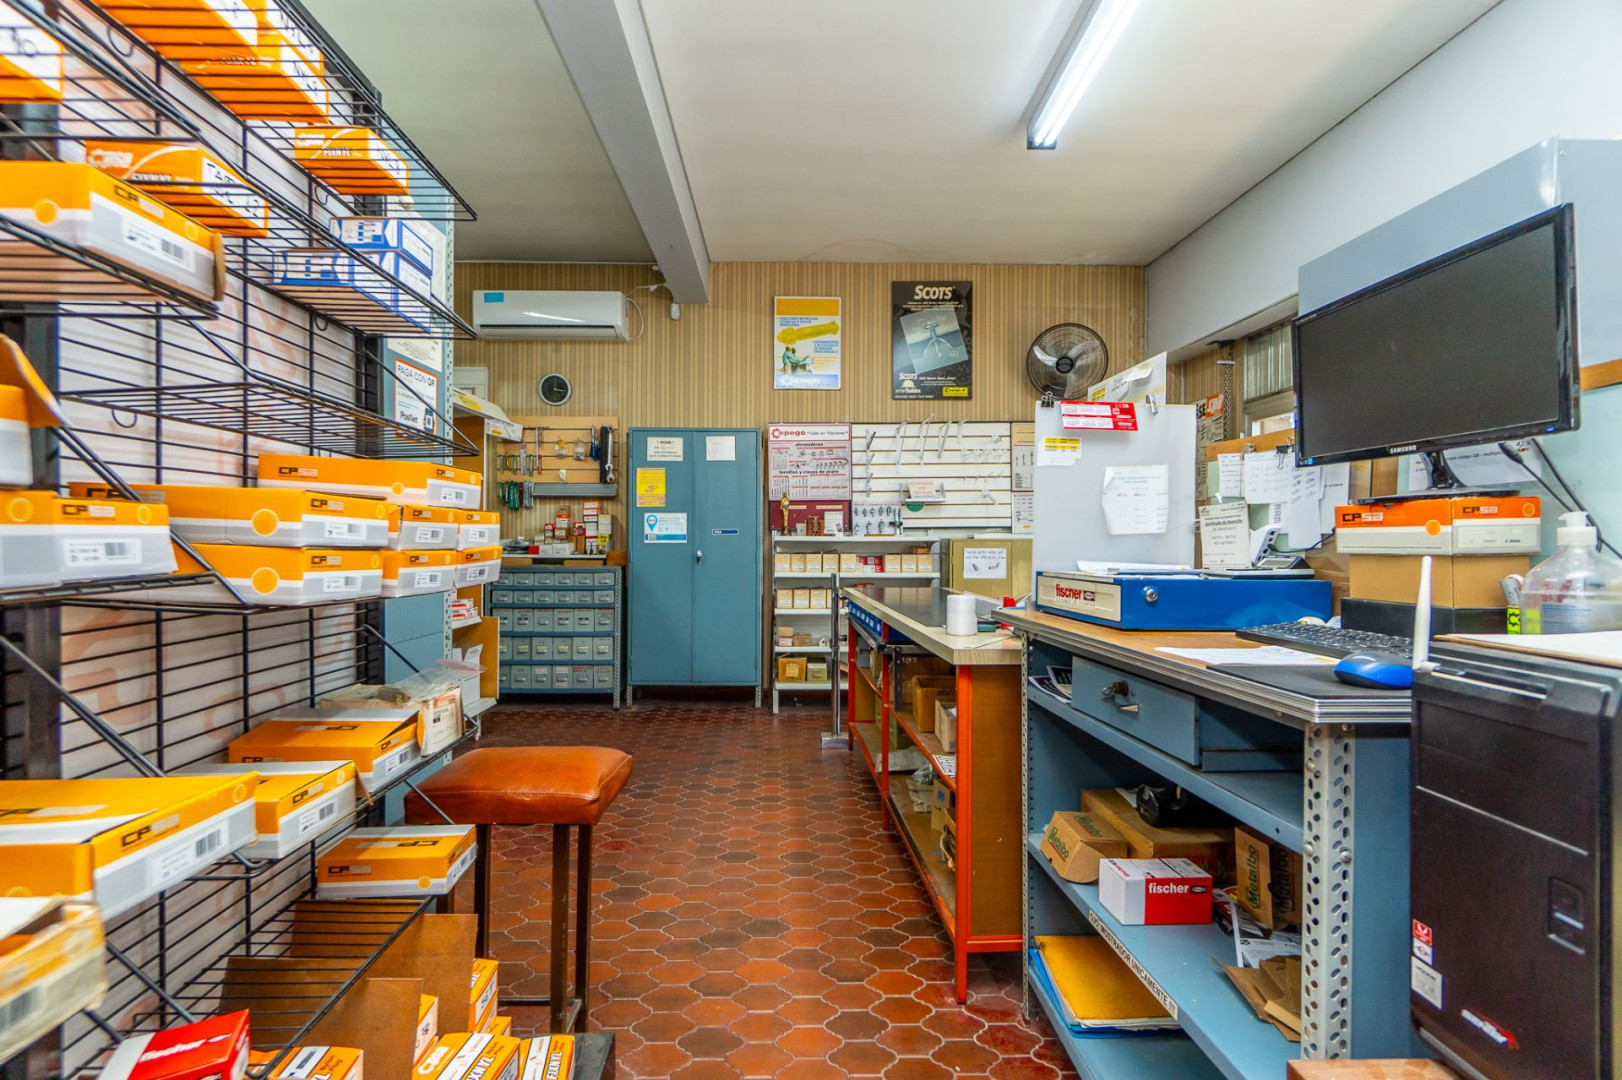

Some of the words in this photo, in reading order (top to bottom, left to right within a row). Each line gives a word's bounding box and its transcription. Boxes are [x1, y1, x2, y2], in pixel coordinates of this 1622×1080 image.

[914, 285, 952, 300] SCOTS
[1390, 445, 1417, 454] SAMSUNG
[1056, 583, 1082, 600] fischer
[1246, 845, 1260, 909] Metalbo
[1148, 882, 1189, 894] fischer
[1100, 924, 1131, 963] MOSTRADOR
[1131, 959, 1168, 1006] UNICAMENTE
